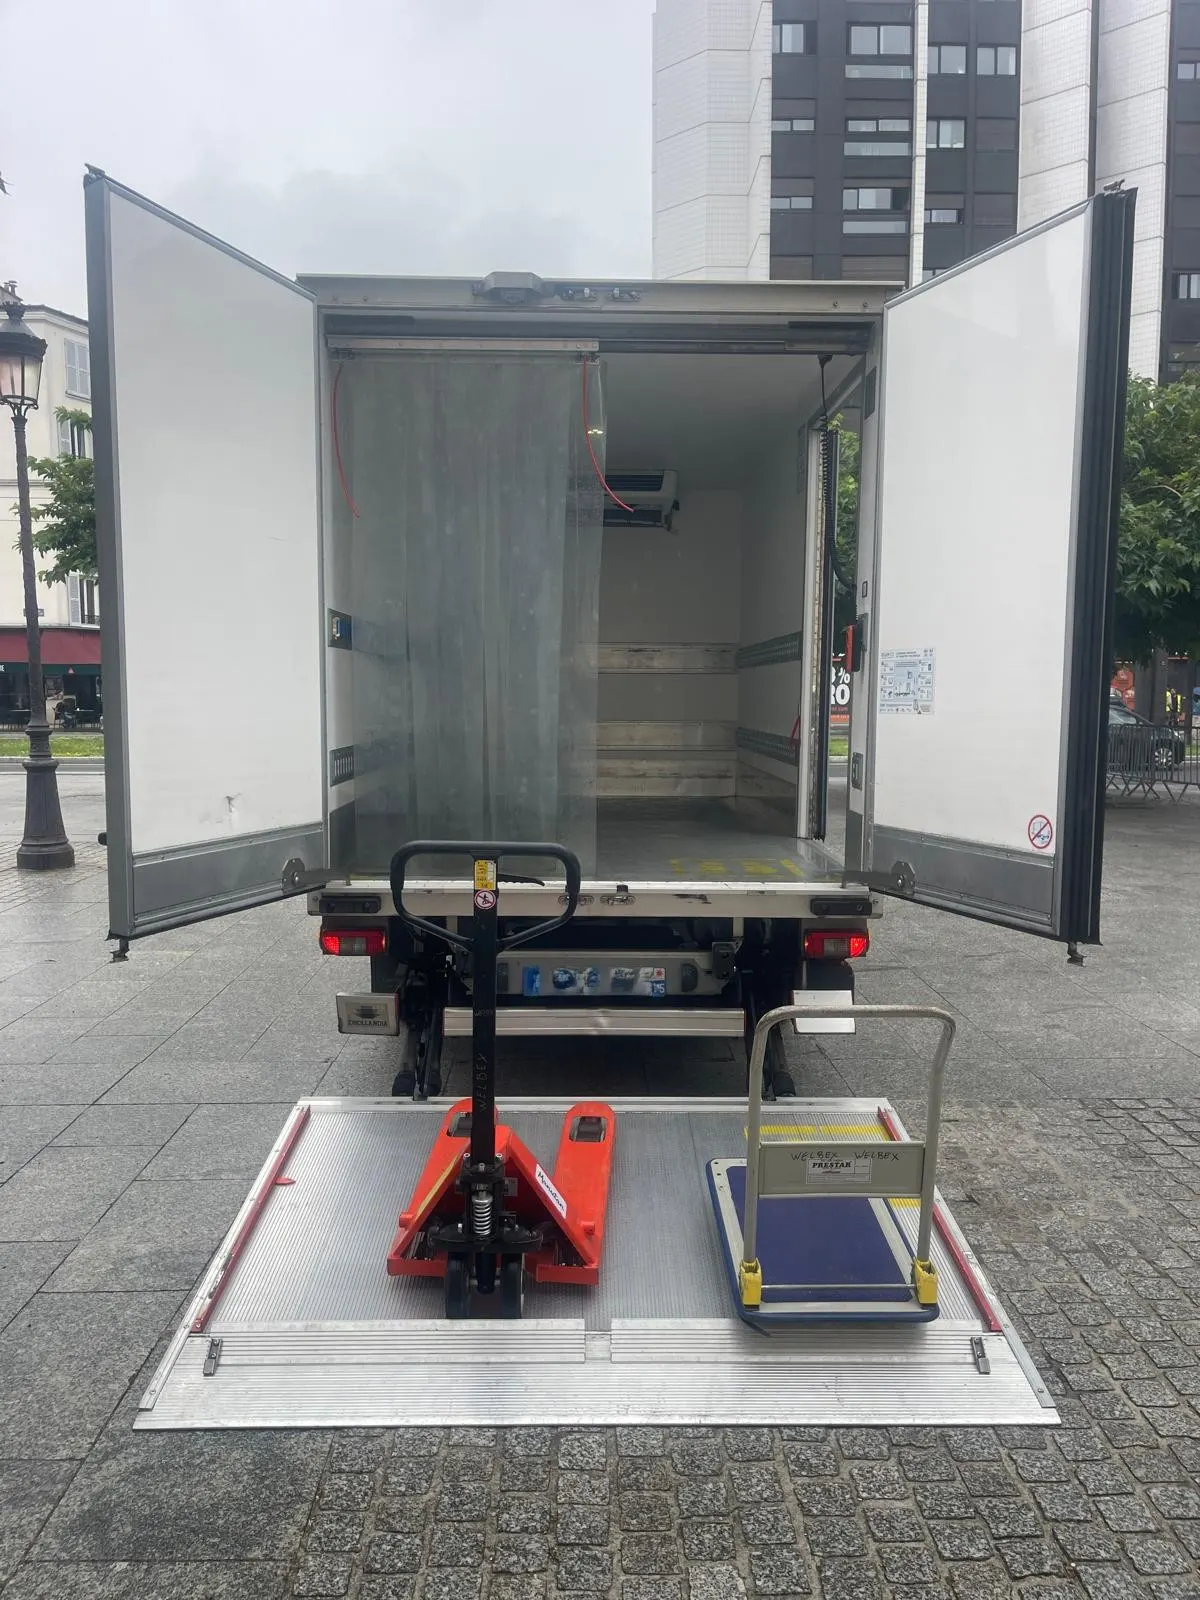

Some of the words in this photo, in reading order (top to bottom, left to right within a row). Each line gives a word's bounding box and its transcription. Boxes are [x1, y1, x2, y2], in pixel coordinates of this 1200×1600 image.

[790, 1150, 839, 1162] WELBEX
[854, 1150, 900, 1162] WELBEX
[812, 1161, 852, 1169] PRESTAR
